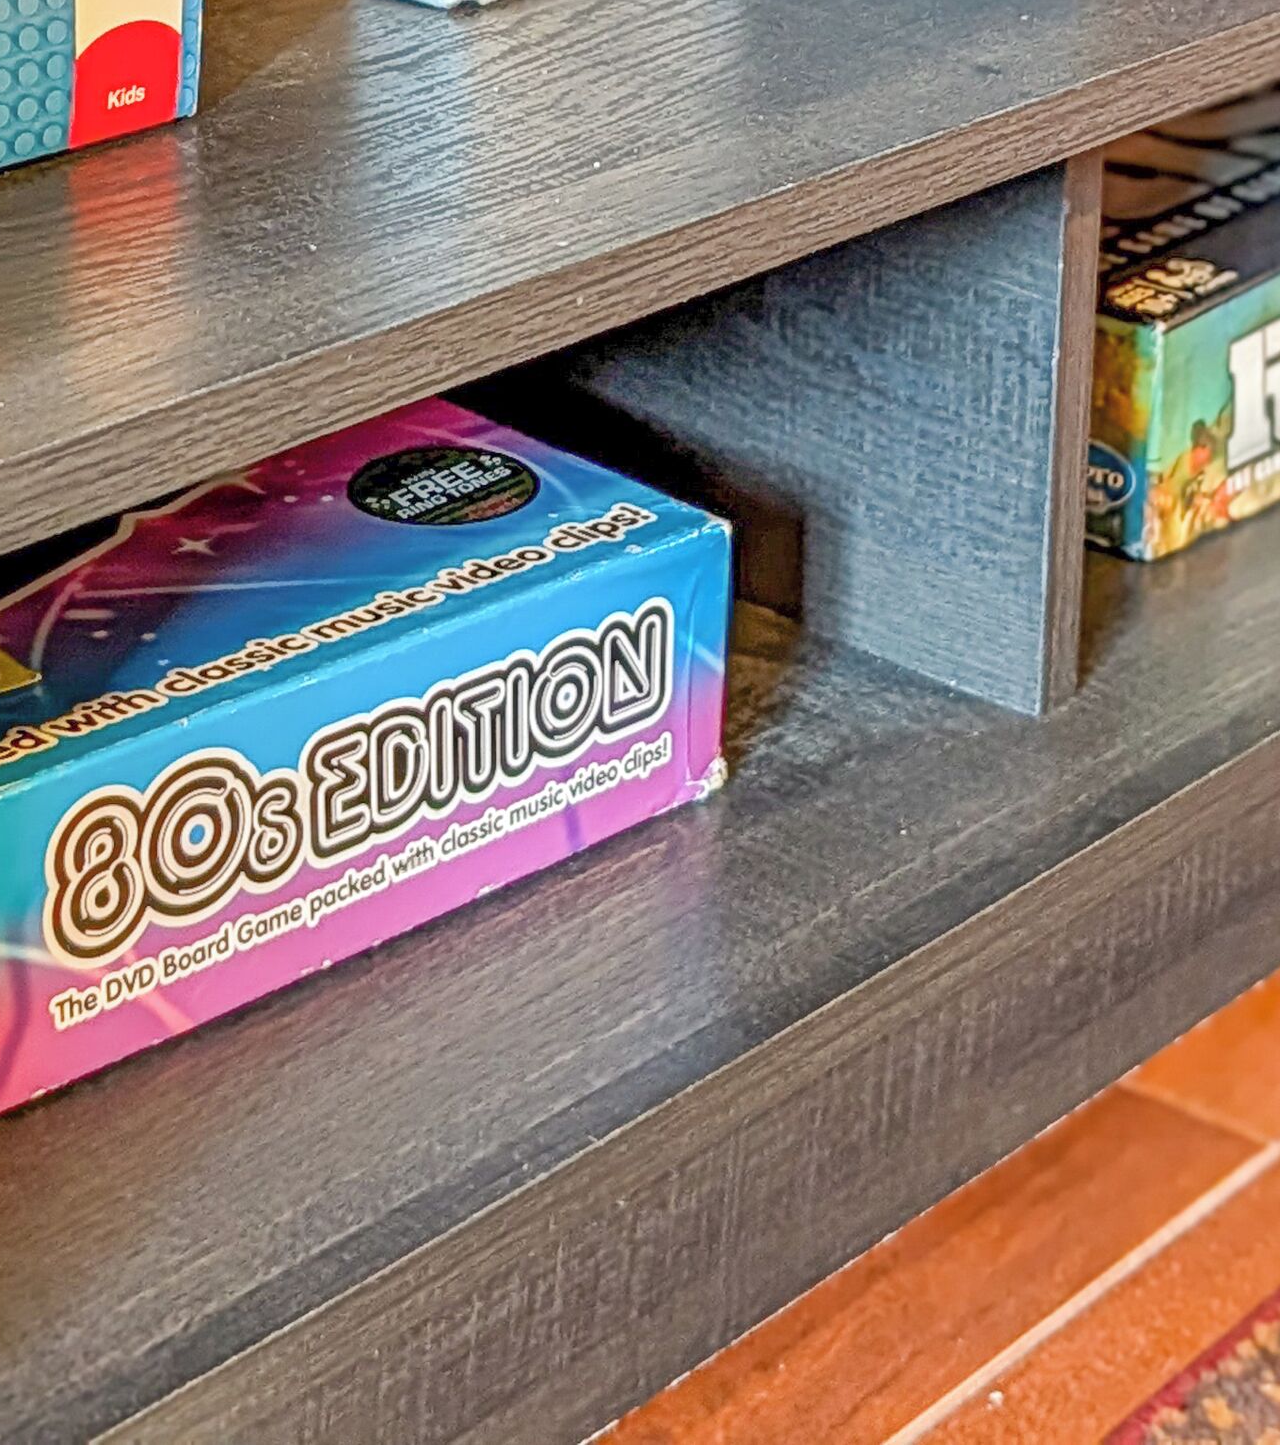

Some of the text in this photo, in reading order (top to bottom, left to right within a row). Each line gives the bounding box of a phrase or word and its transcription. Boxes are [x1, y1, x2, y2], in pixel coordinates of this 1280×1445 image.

[107, 84, 146, 110] Kids
[388, 461, 484, 507] FREE
[396, 493, 449, 520] RING
[447, 465, 513, 498] TONES
[58, 687, 161, 732] with
[163, 632, 308, 696] classic
[311, 585, 427, 640] music
[434, 542, 546, 594] video
[552, 506, 651, 552] clips!
[53, 604, 669, 958] 80s EDITION
[54, 734, 670, 1026] The DVD Board Game packed with classic music video clips!
